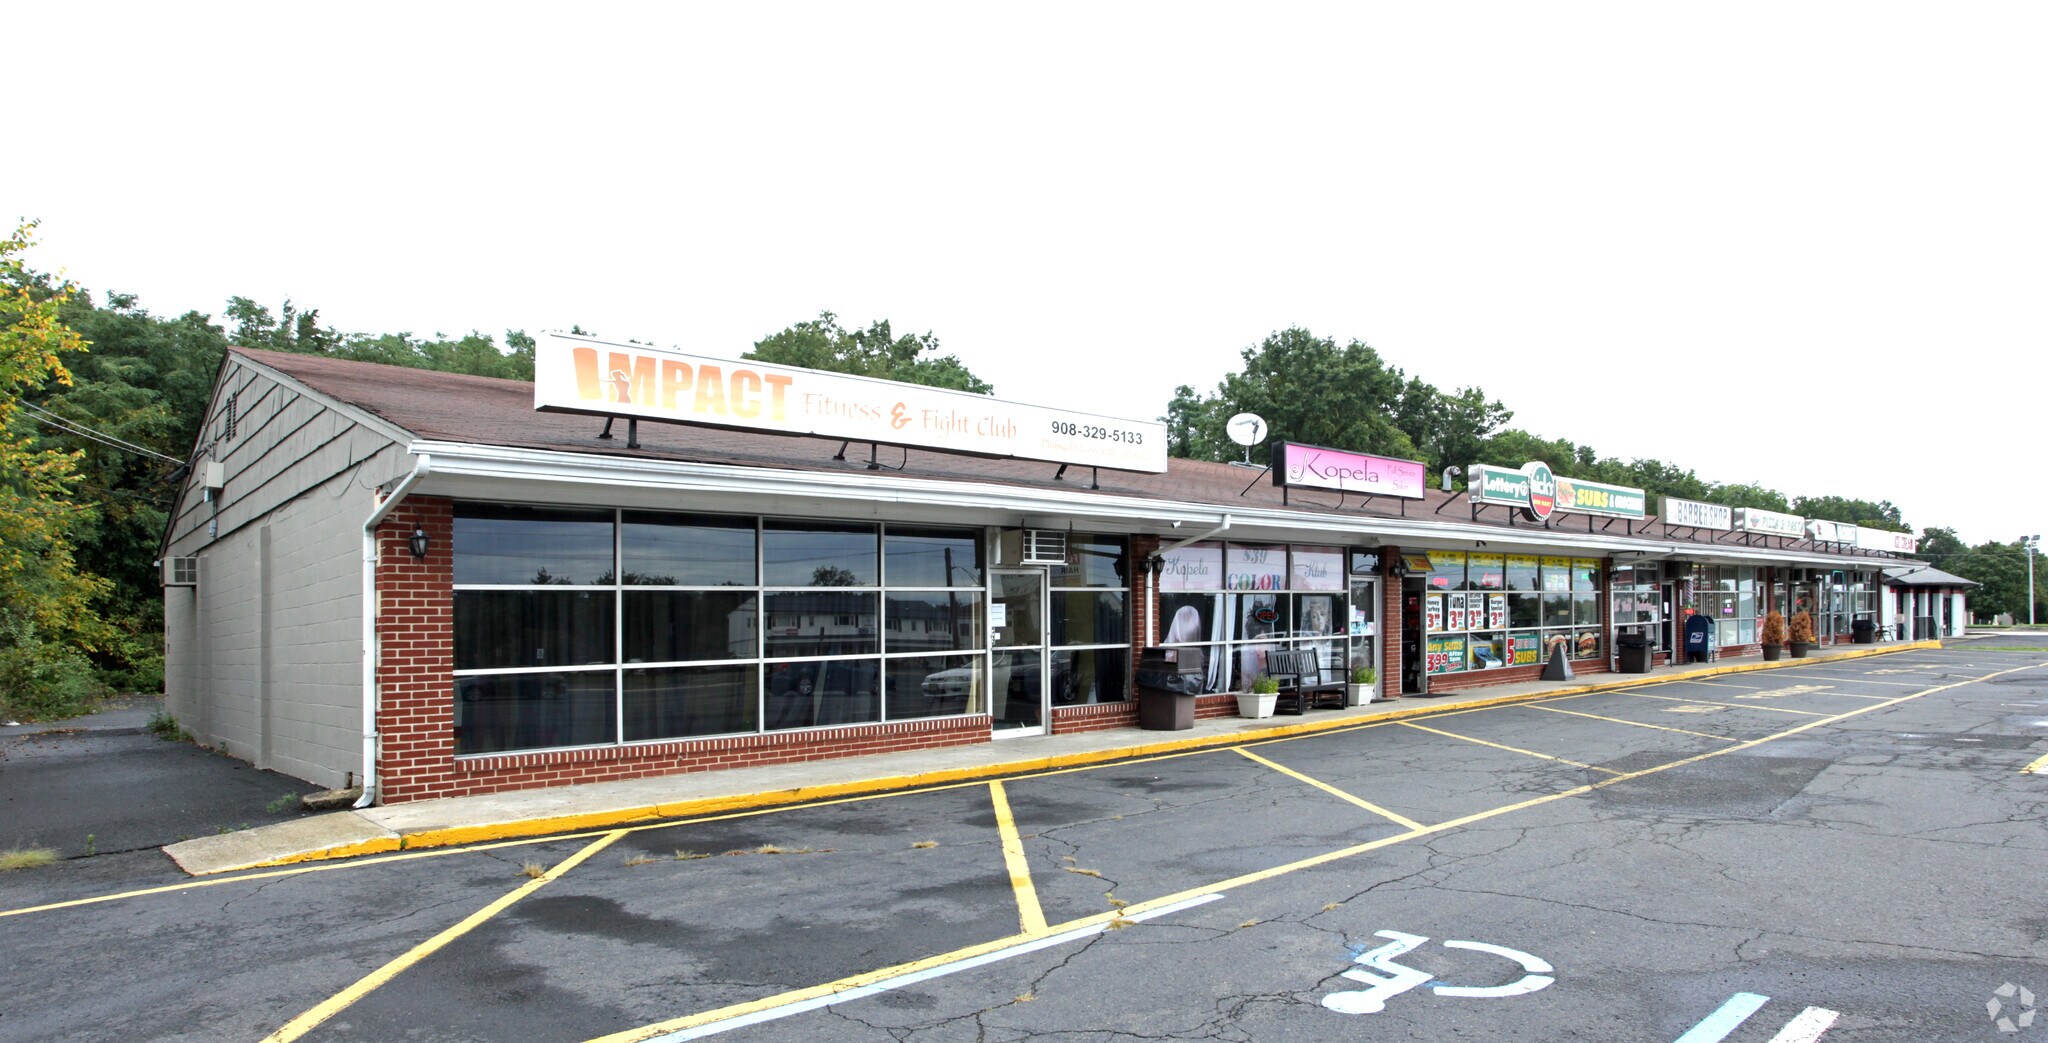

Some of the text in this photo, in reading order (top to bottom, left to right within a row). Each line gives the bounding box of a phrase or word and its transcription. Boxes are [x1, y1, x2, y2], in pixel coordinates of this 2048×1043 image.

[573, 347, 793, 421] IMPACT
[803, 393, 1018, 440] Fitness & Fight Club
[1052, 421, 1143, 445] 908-329-5133
[1290, 452, 1379, 488] Kopela
[1577, 488, 1608, 508] SUBS
[1677, 502, 1728, 528] BARBER SHOP
[1166, 556, 1209, 582] Kopela
[1228, 573, 1281, 590] COLOR
[1257, 610, 1277, 621] OPEN
[1427, 641, 1463, 652] Any SUBS
[1515, 650, 1537, 664] SUBS
